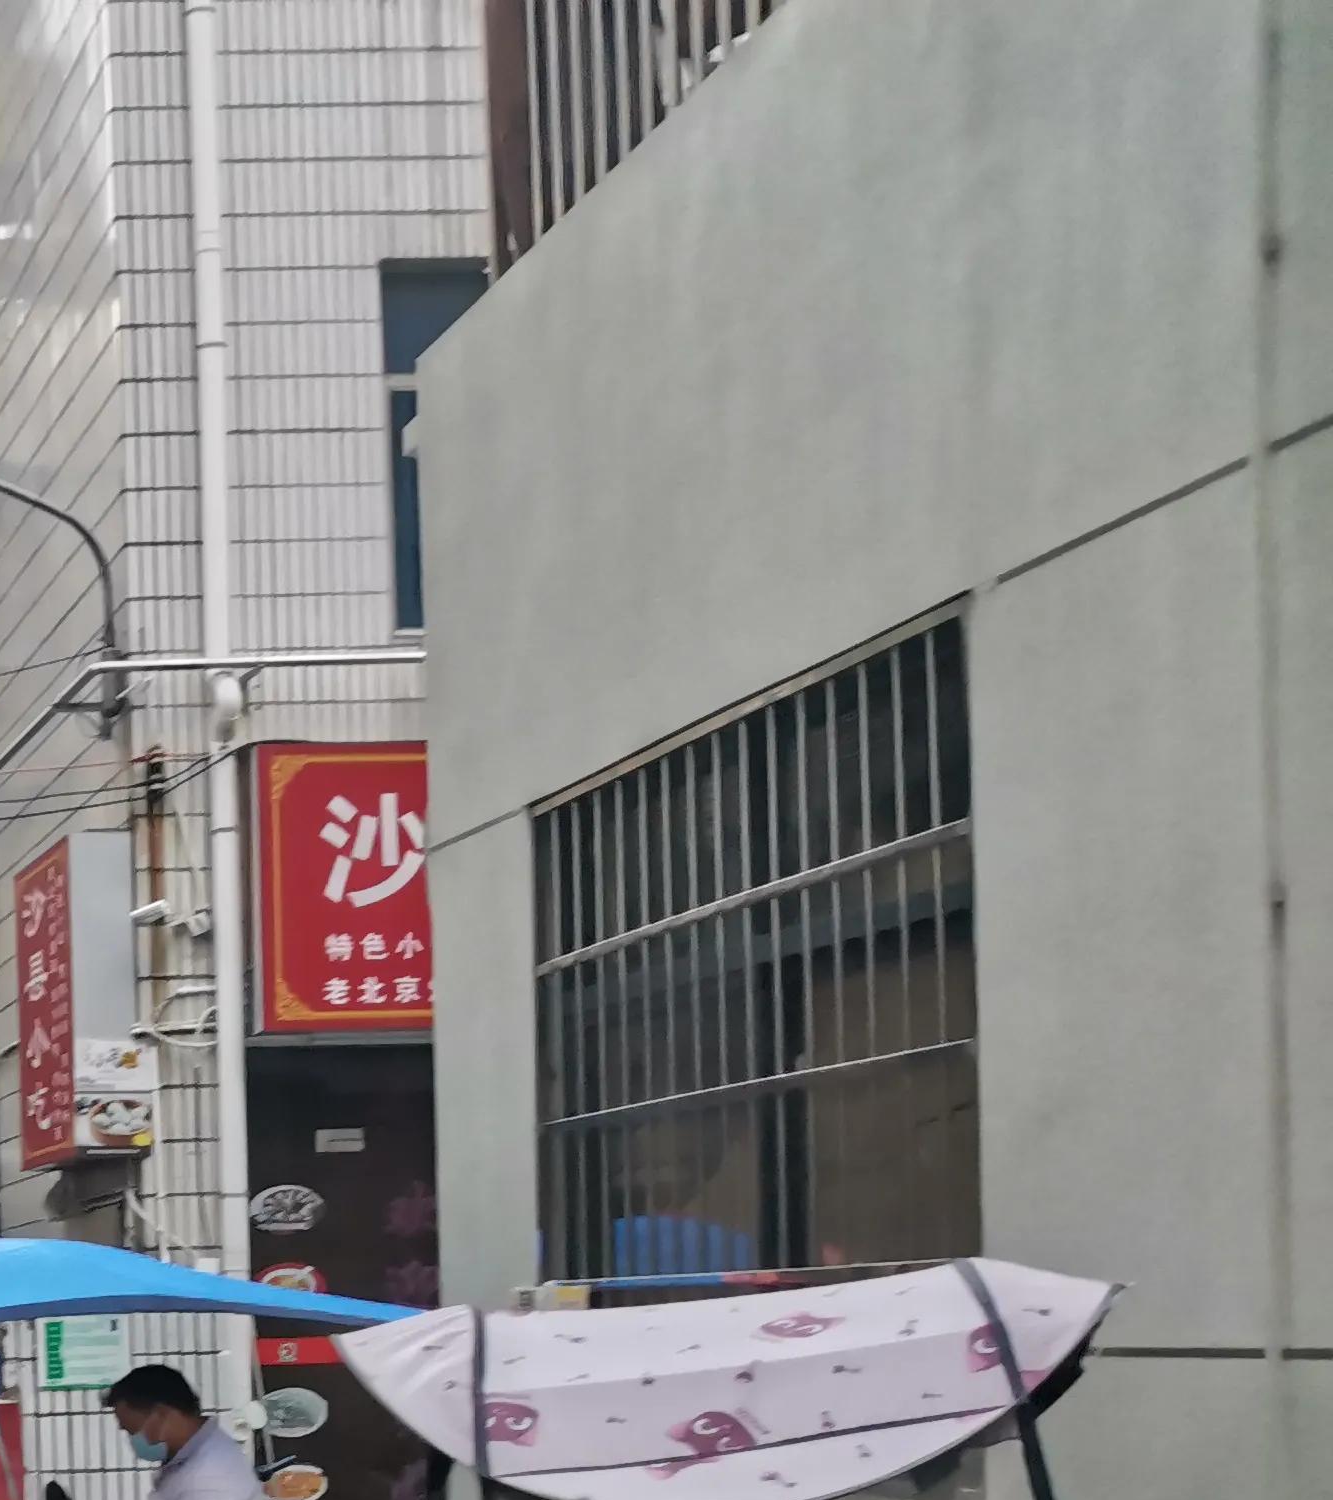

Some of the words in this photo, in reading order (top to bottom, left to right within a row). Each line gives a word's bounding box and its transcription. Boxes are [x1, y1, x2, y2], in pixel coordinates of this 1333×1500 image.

[318, 792, 427, 908] 沙
[323, 931, 425, 962] 特色小
[21, 888, 52, 1131] 沙县小吃
[322, 975, 434, 1005] 老北京
